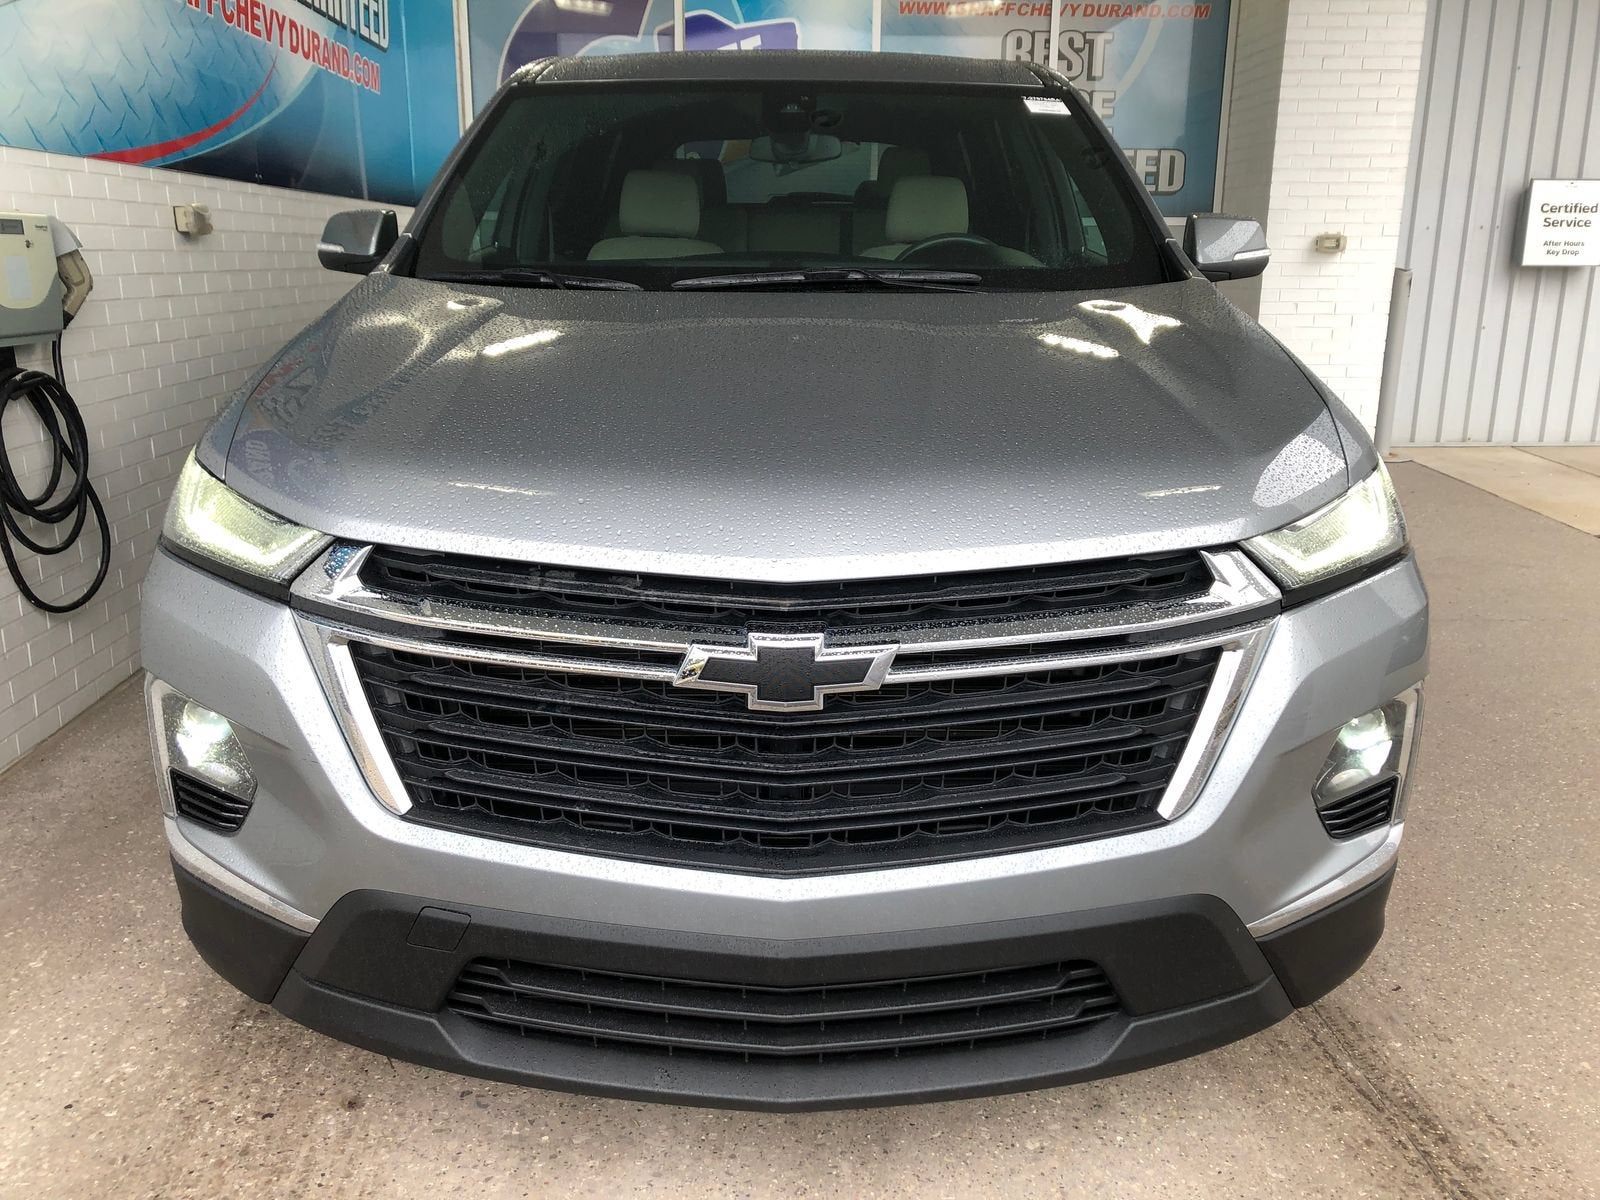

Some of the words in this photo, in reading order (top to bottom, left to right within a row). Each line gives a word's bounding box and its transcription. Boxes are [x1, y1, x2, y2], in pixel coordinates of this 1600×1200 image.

[186, 0, 380, 94] CHEVYDURAND.COM
[1002, 28, 1114, 81] BEST
[1540, 202, 1599, 214] Certified
[1543, 217, 1592, 228] Service
